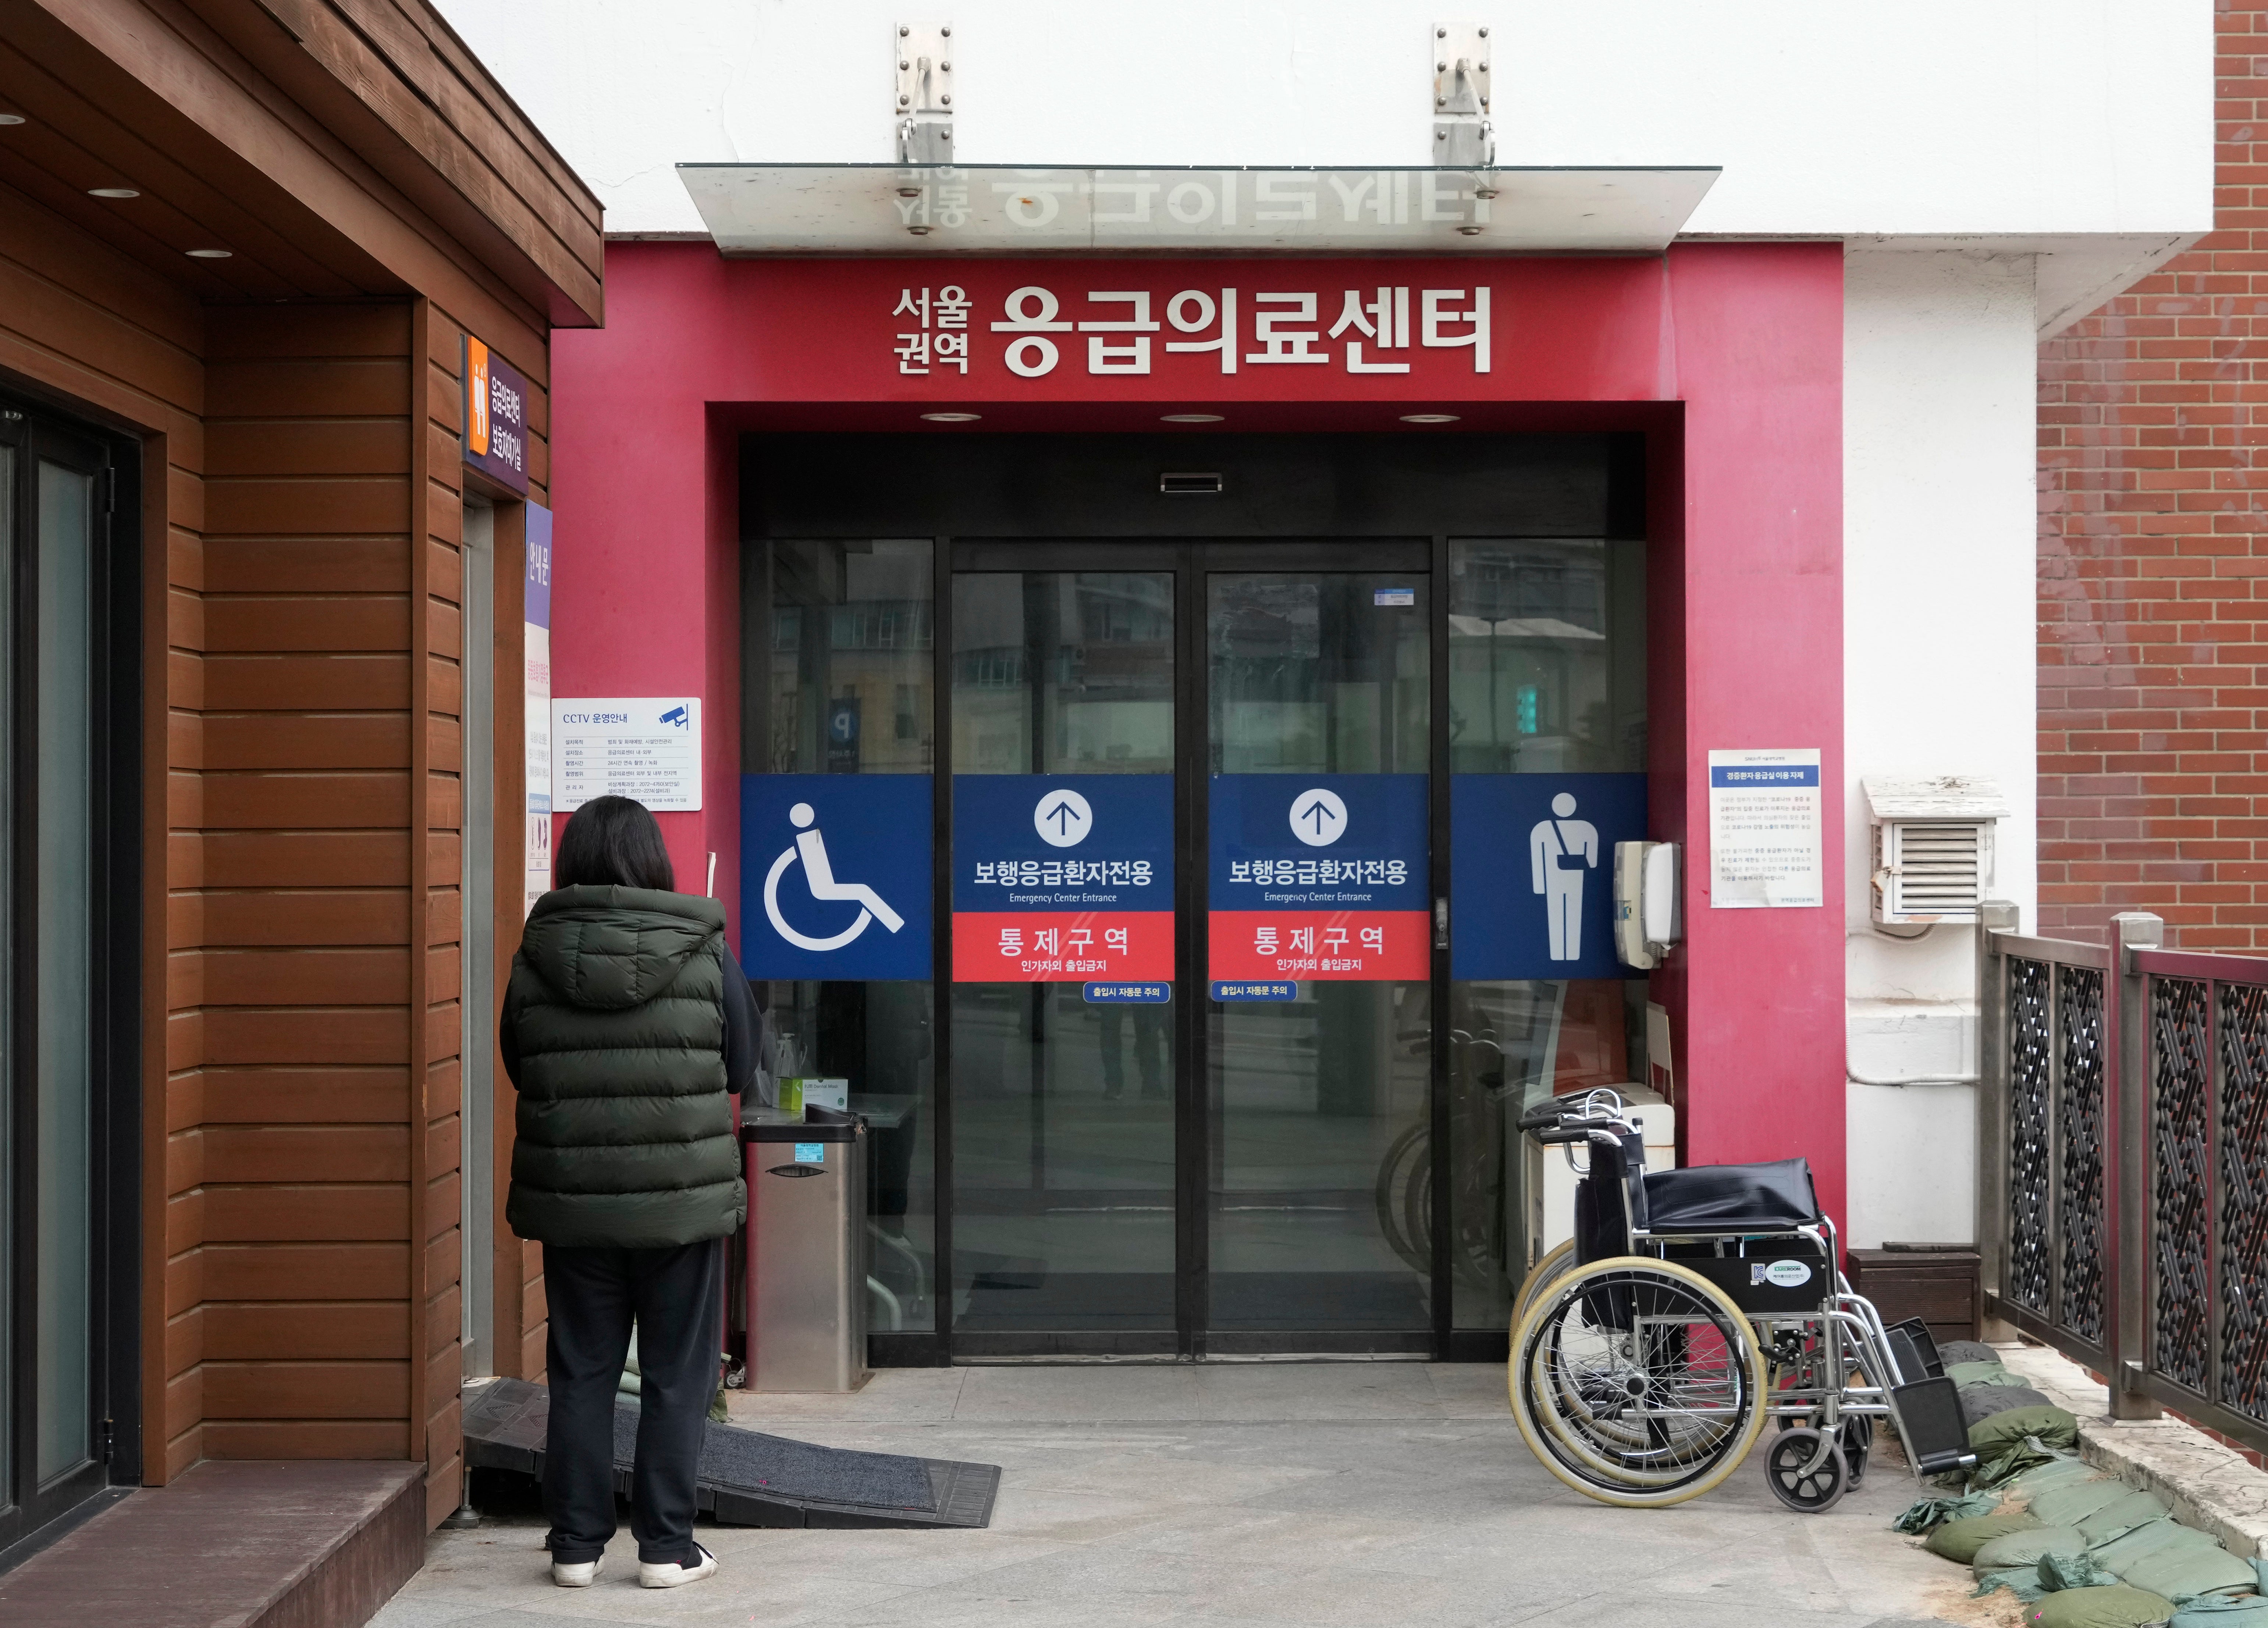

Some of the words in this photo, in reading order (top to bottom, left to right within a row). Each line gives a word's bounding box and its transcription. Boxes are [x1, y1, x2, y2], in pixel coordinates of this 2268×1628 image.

[892, 285, 972, 329] 서울
[991, 286, 1490, 377] 응급의료센터
[894, 332, 968, 374] 권역
[492, 376, 520, 427] 응급의료센터
[493, 423, 521, 472] 보호자대기실
[530, 541, 548, 586] 안내문
[563, 714, 589, 723] CCTV
[592, 713, 628, 724] 운영안내
[1755, 772, 1775, 780] 응급실
[1776, 771, 1789, 779] 이용
[974, 861, 1153, 886] 보행응급환자전용
[1229, 860, 1408, 885] 보행응급환자전용
[1010, 893, 1052, 904] Emergency
[1054, 893, 1080, 902] Center
[1083, 893, 1117, 902] Entrance
[1265, 892, 1307, 903] Emergency
[1309, 892, 1335, 901] Center
[1337, 892, 1372, 901] Entrance
[1021, 960, 1062, 972] 인가자외
[1065, 960, 1107, 972] 출입금지
[1276, 959, 1317, 971] 인가자외
[1321, 959, 1362, 971] 출입금지
[1093, 988, 1116, 997] 출입시
[1119, 988, 1142, 996] 자동문
[1144, 987, 1160, 996] 주의
[1220, 987, 1244, 996] 출입시
[1246, 986, 1269, 995] 자동문
[1272, 986, 1287, 995] 주의
